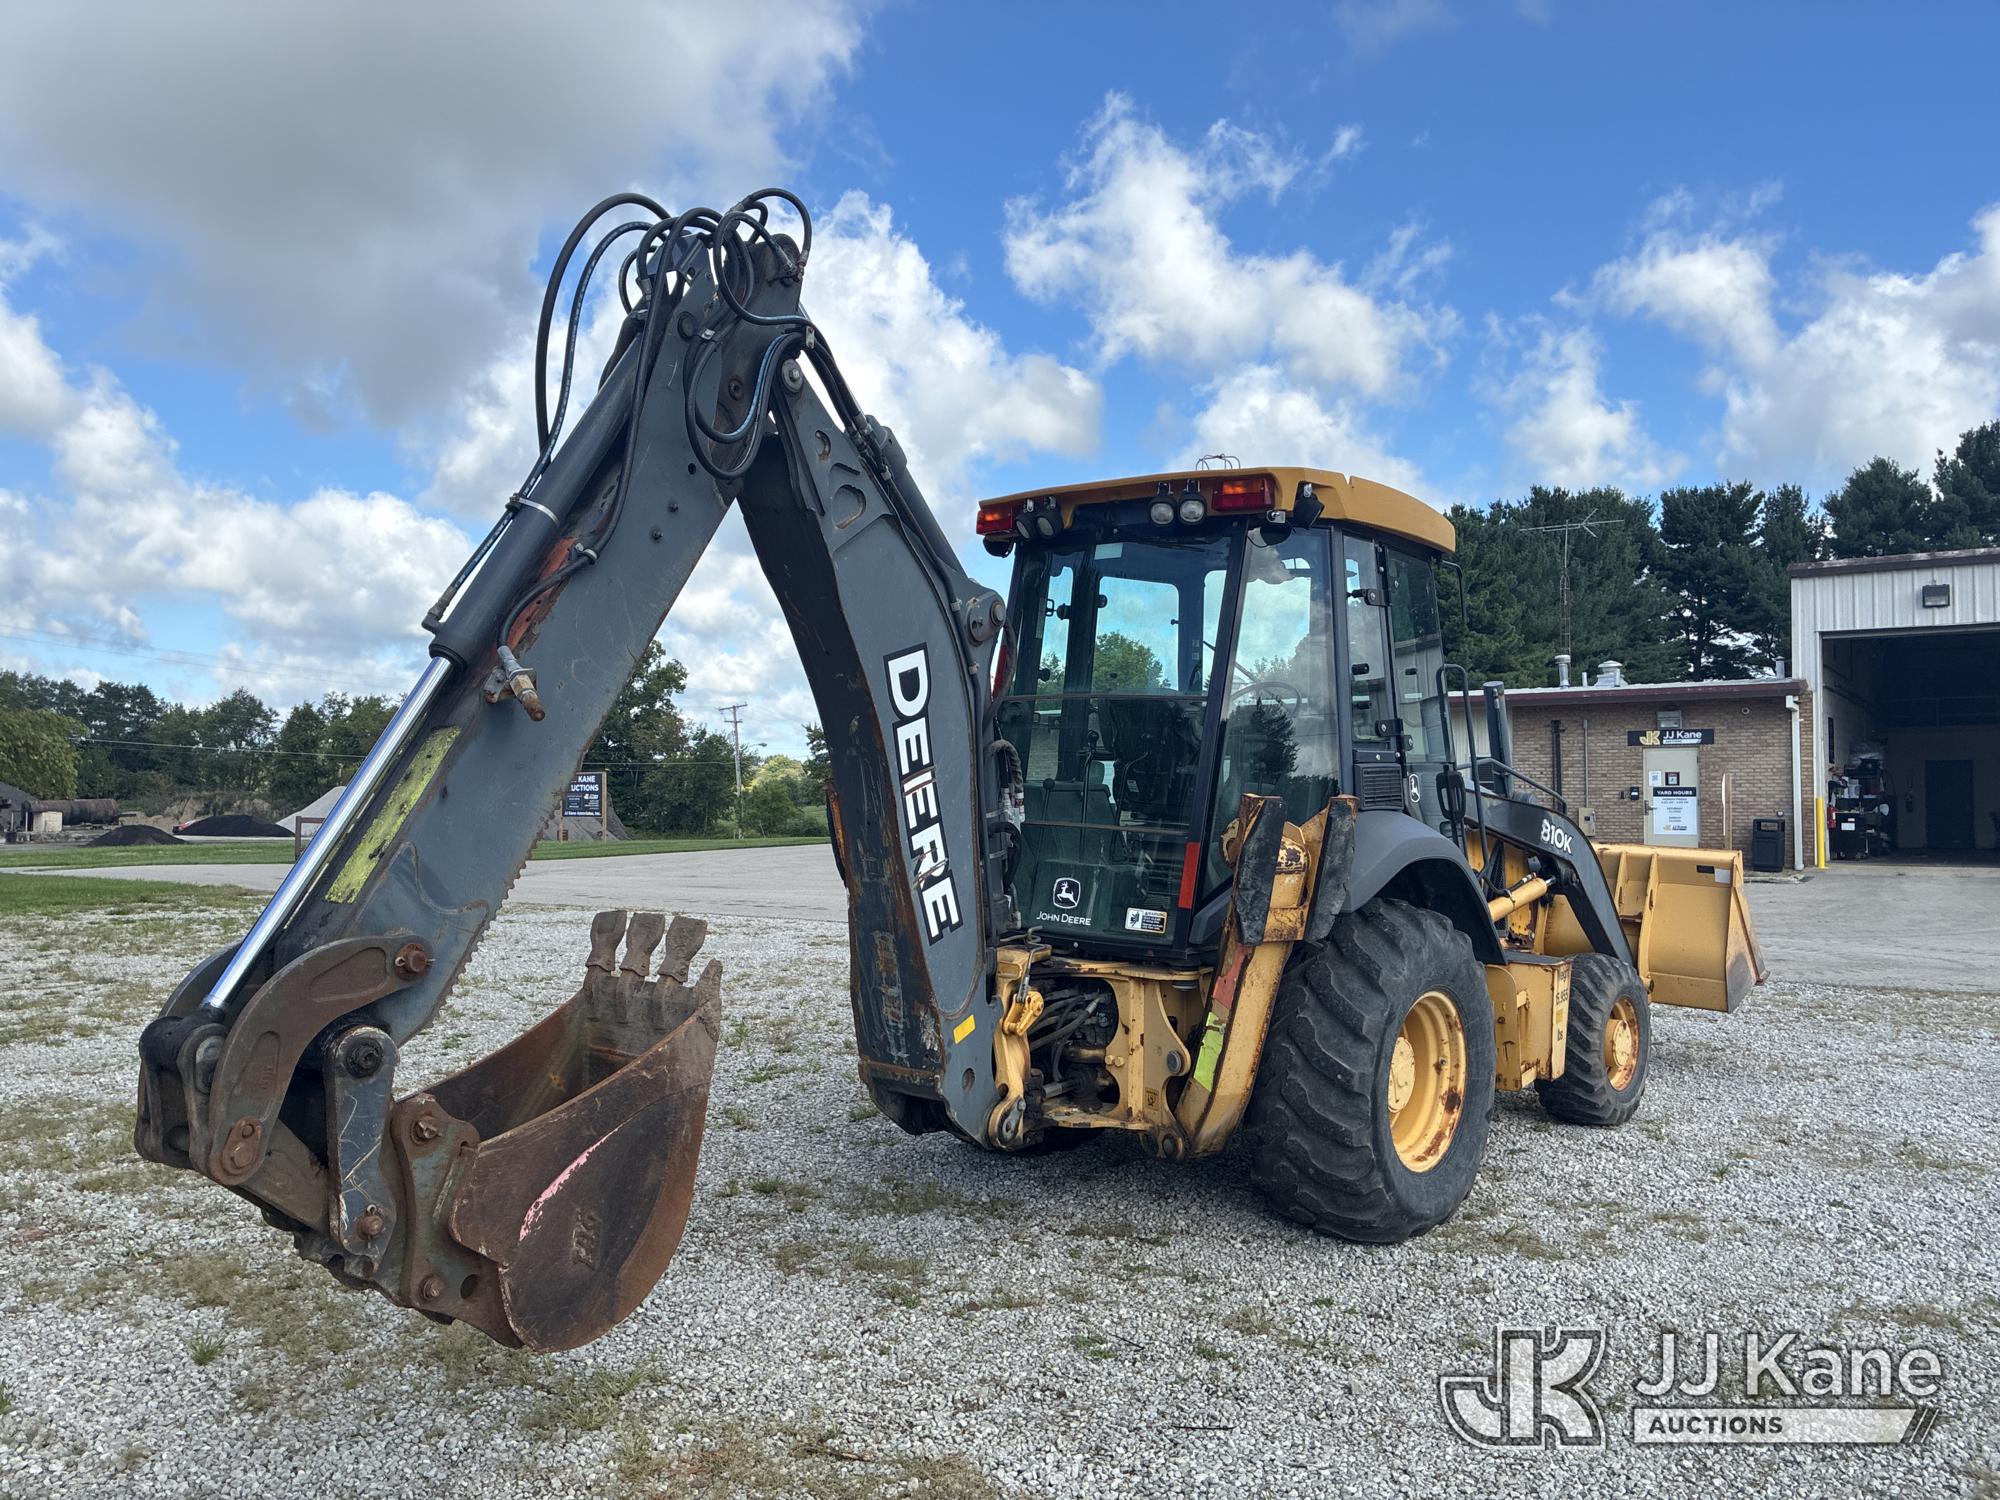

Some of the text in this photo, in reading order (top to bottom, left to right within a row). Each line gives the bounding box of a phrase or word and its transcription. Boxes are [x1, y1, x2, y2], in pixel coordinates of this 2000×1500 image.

[1663, 731, 1702, 739] JJ Kane
[578, 775, 596, 783] KANE
[570, 784, 599, 792] UCTIONS
[886, 647, 961, 940] DEERE
[1036, 910, 1091, 926] JOHN DEERE
